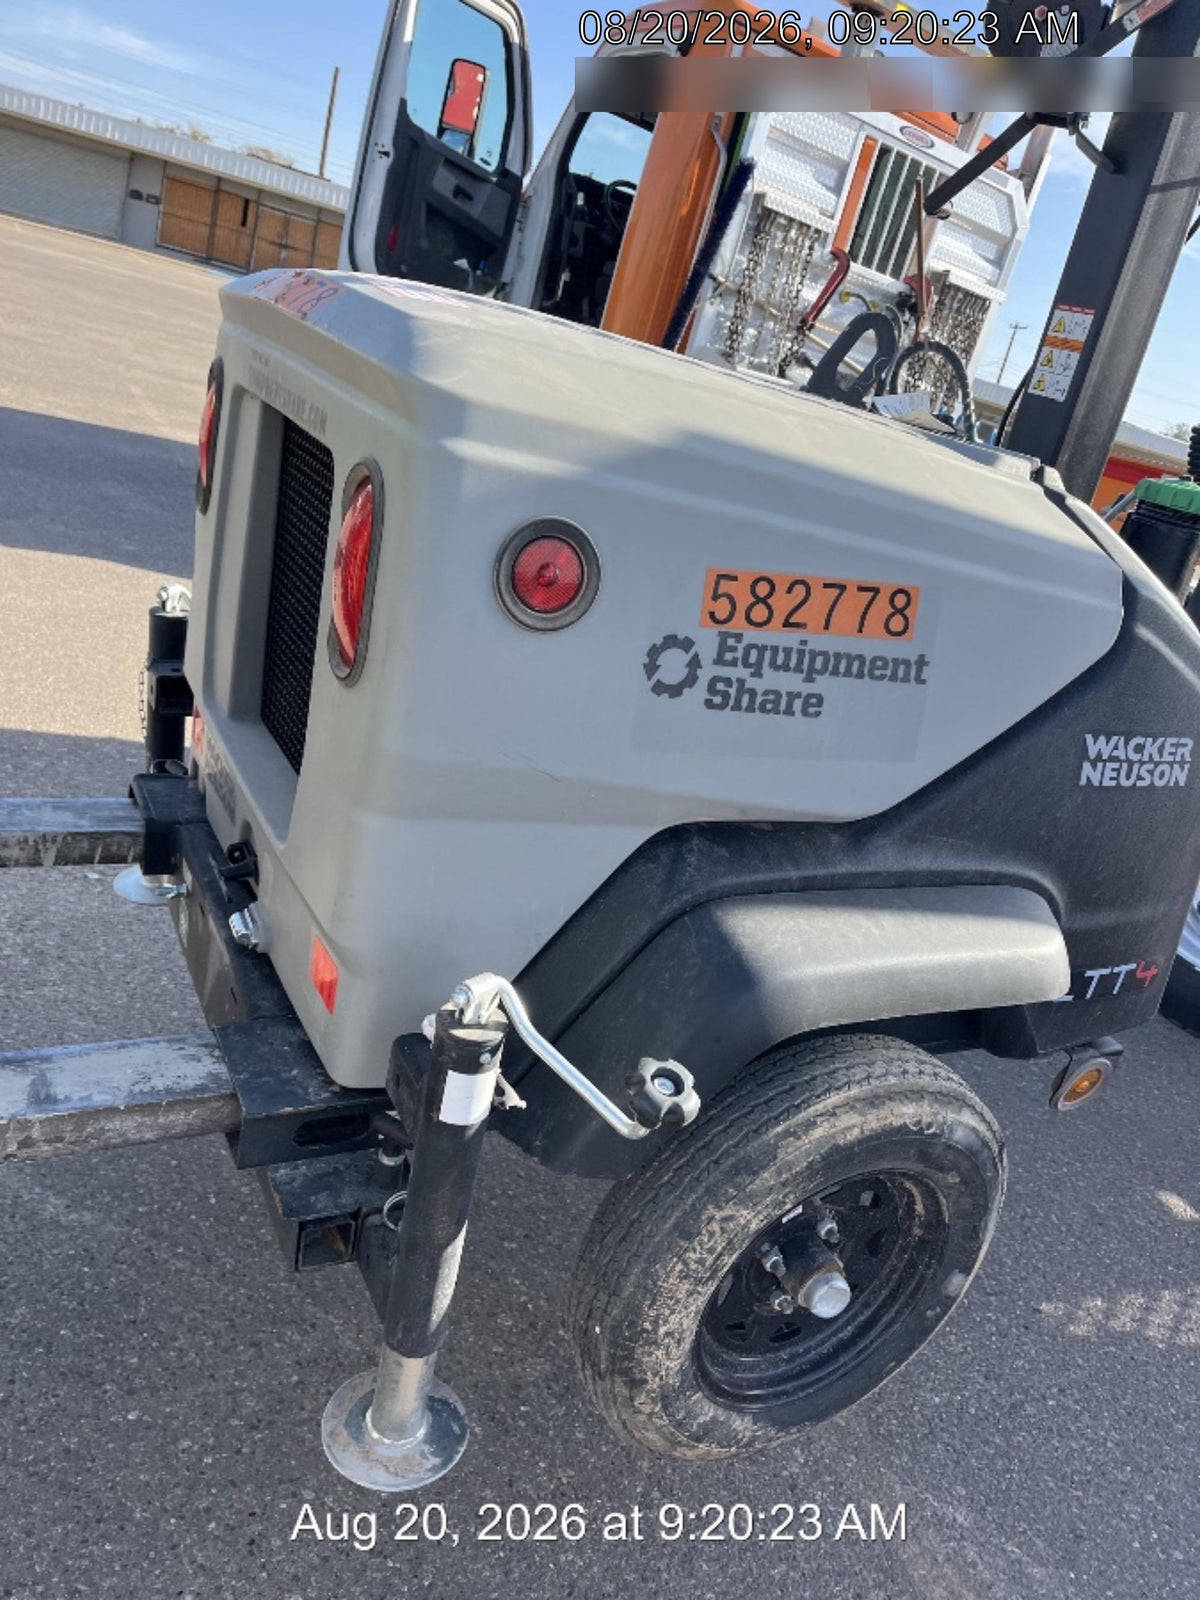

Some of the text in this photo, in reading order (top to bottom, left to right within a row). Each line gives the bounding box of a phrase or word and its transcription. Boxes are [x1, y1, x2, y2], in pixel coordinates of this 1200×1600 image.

[707, 573, 913, 638] 582778
[711, 630, 931, 685] Equipment
[703, 675, 825, 719] Share
[1084, 733, 1194, 762] WACKER
[1079, 761, 1191, 788] NEUSON
[1053, 959, 1159, 1003] TT4
